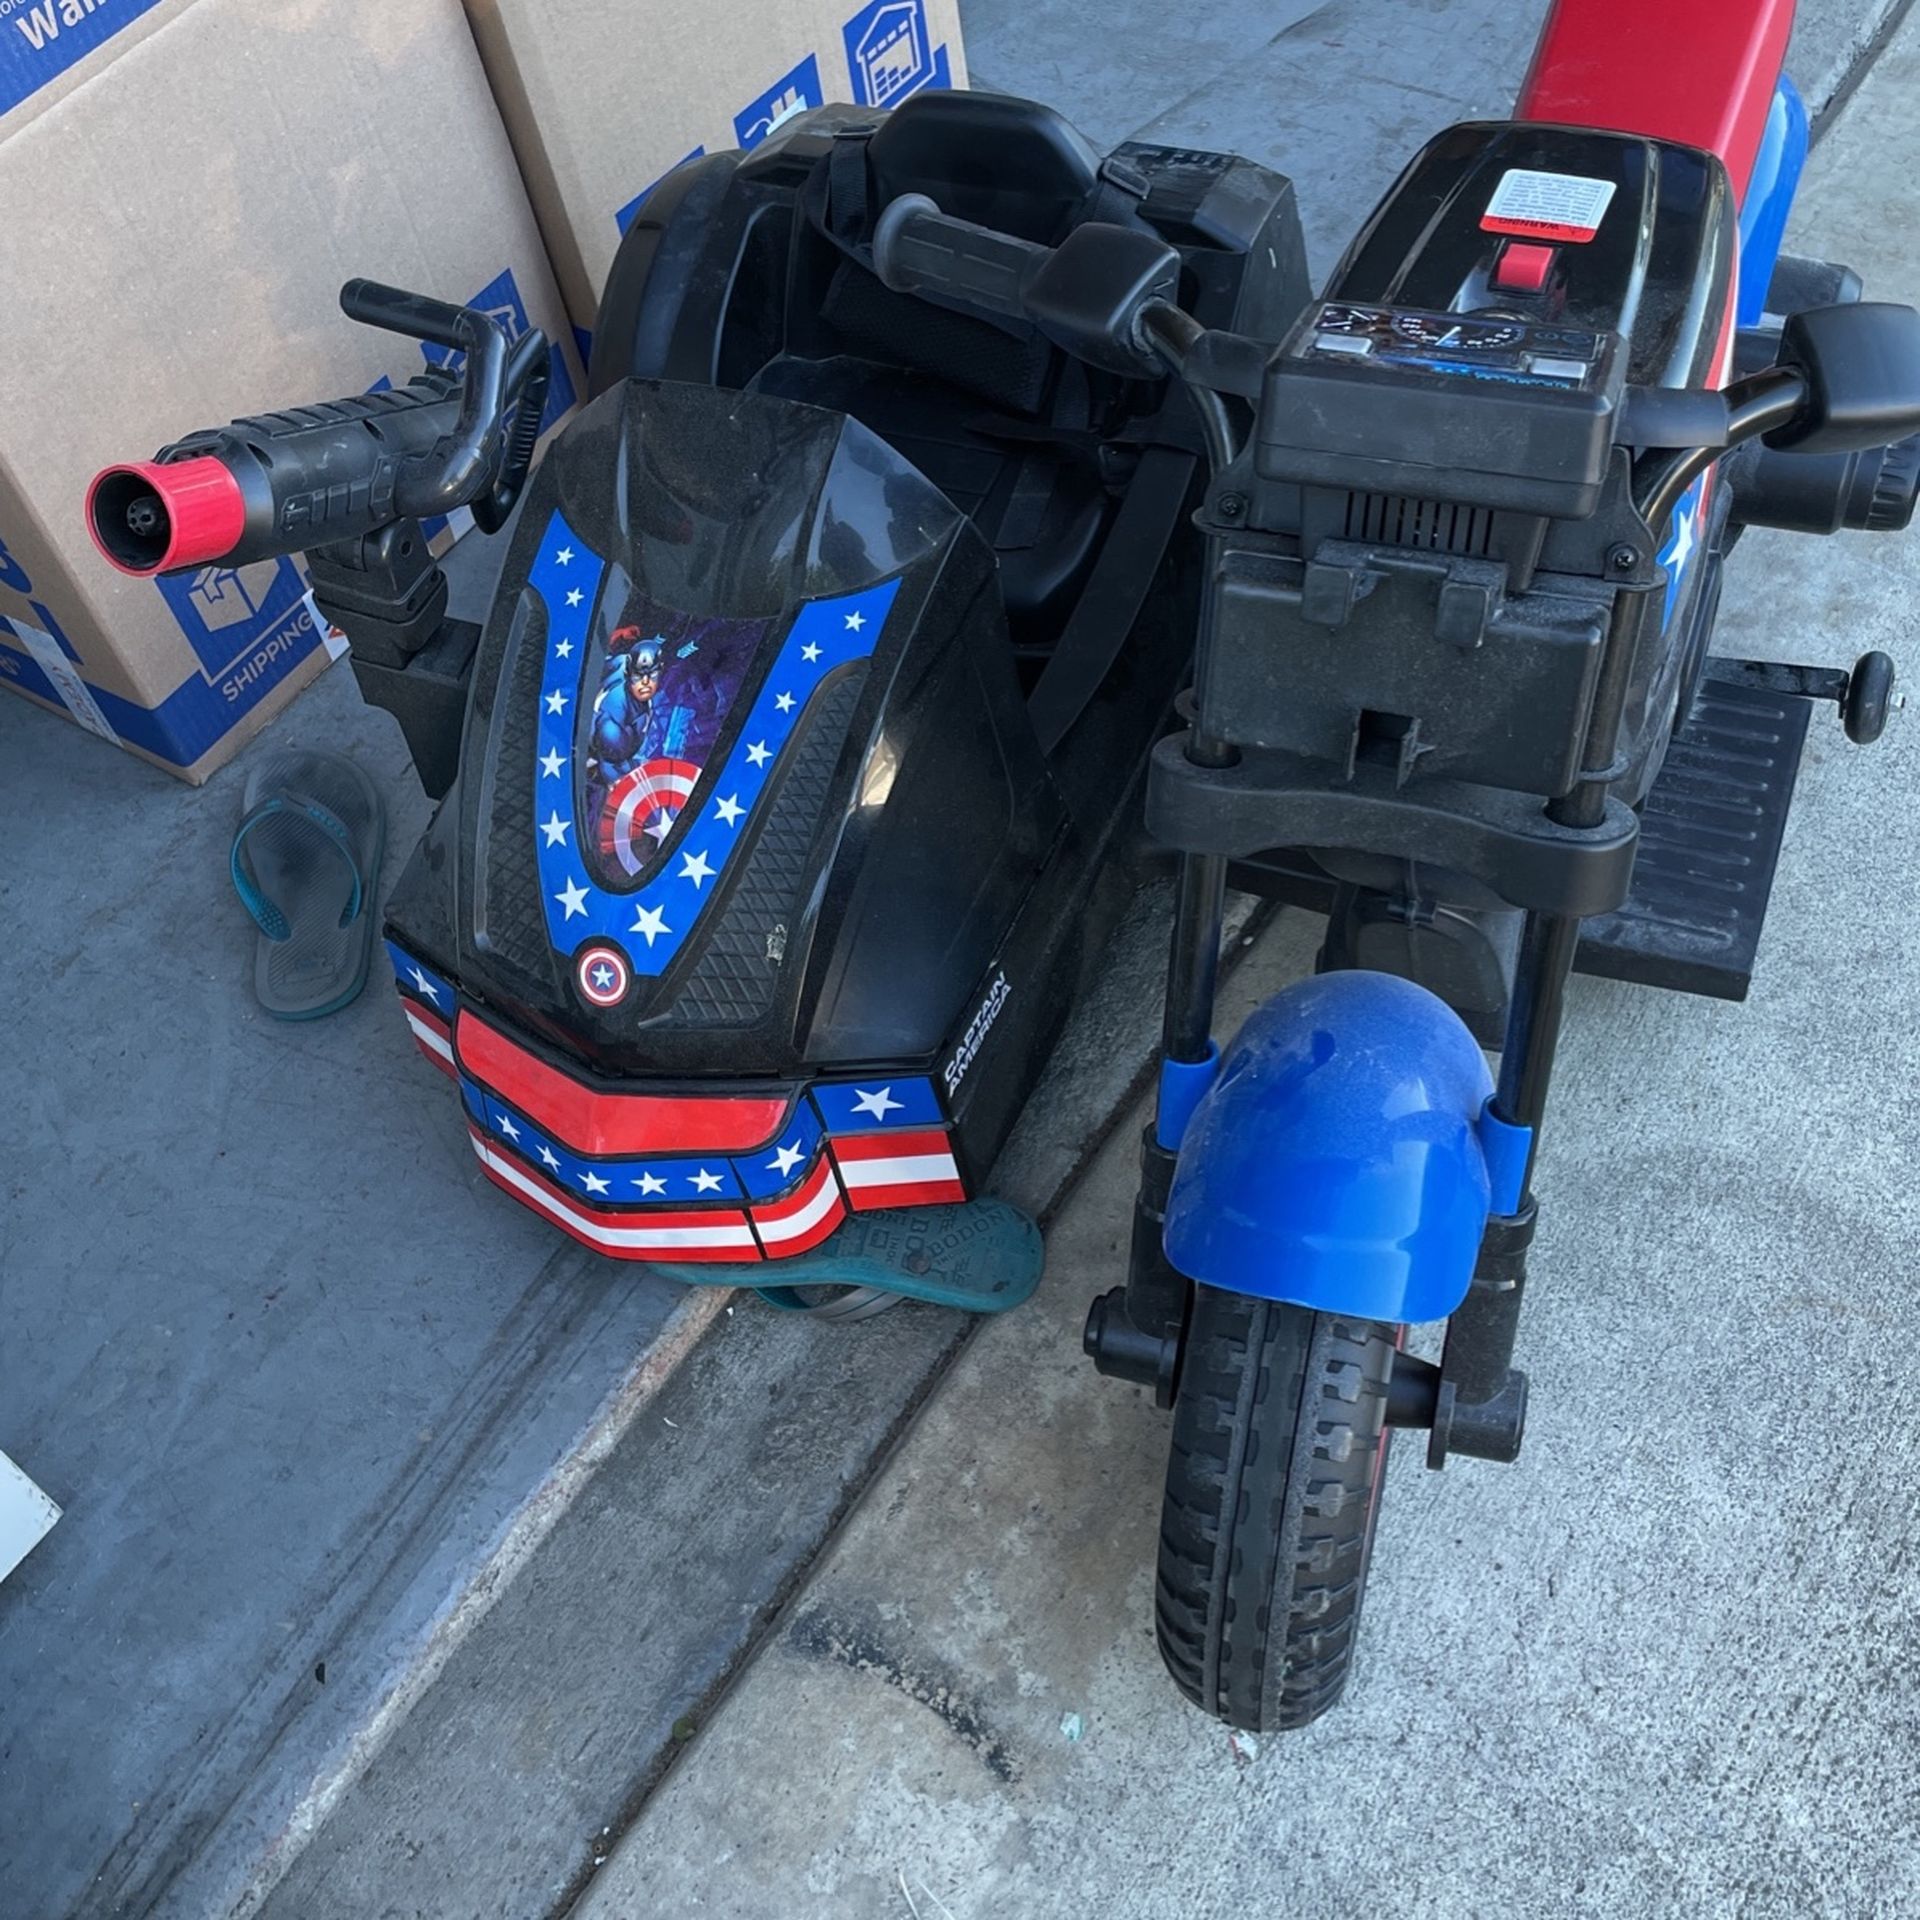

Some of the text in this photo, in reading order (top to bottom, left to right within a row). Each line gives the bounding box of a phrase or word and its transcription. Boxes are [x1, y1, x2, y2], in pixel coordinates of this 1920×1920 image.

[222, 611, 314, 702] SHIPPING
[945, 970, 1006, 1083] CAPTAIN
[949, 984, 1012, 1099] AMERICA
